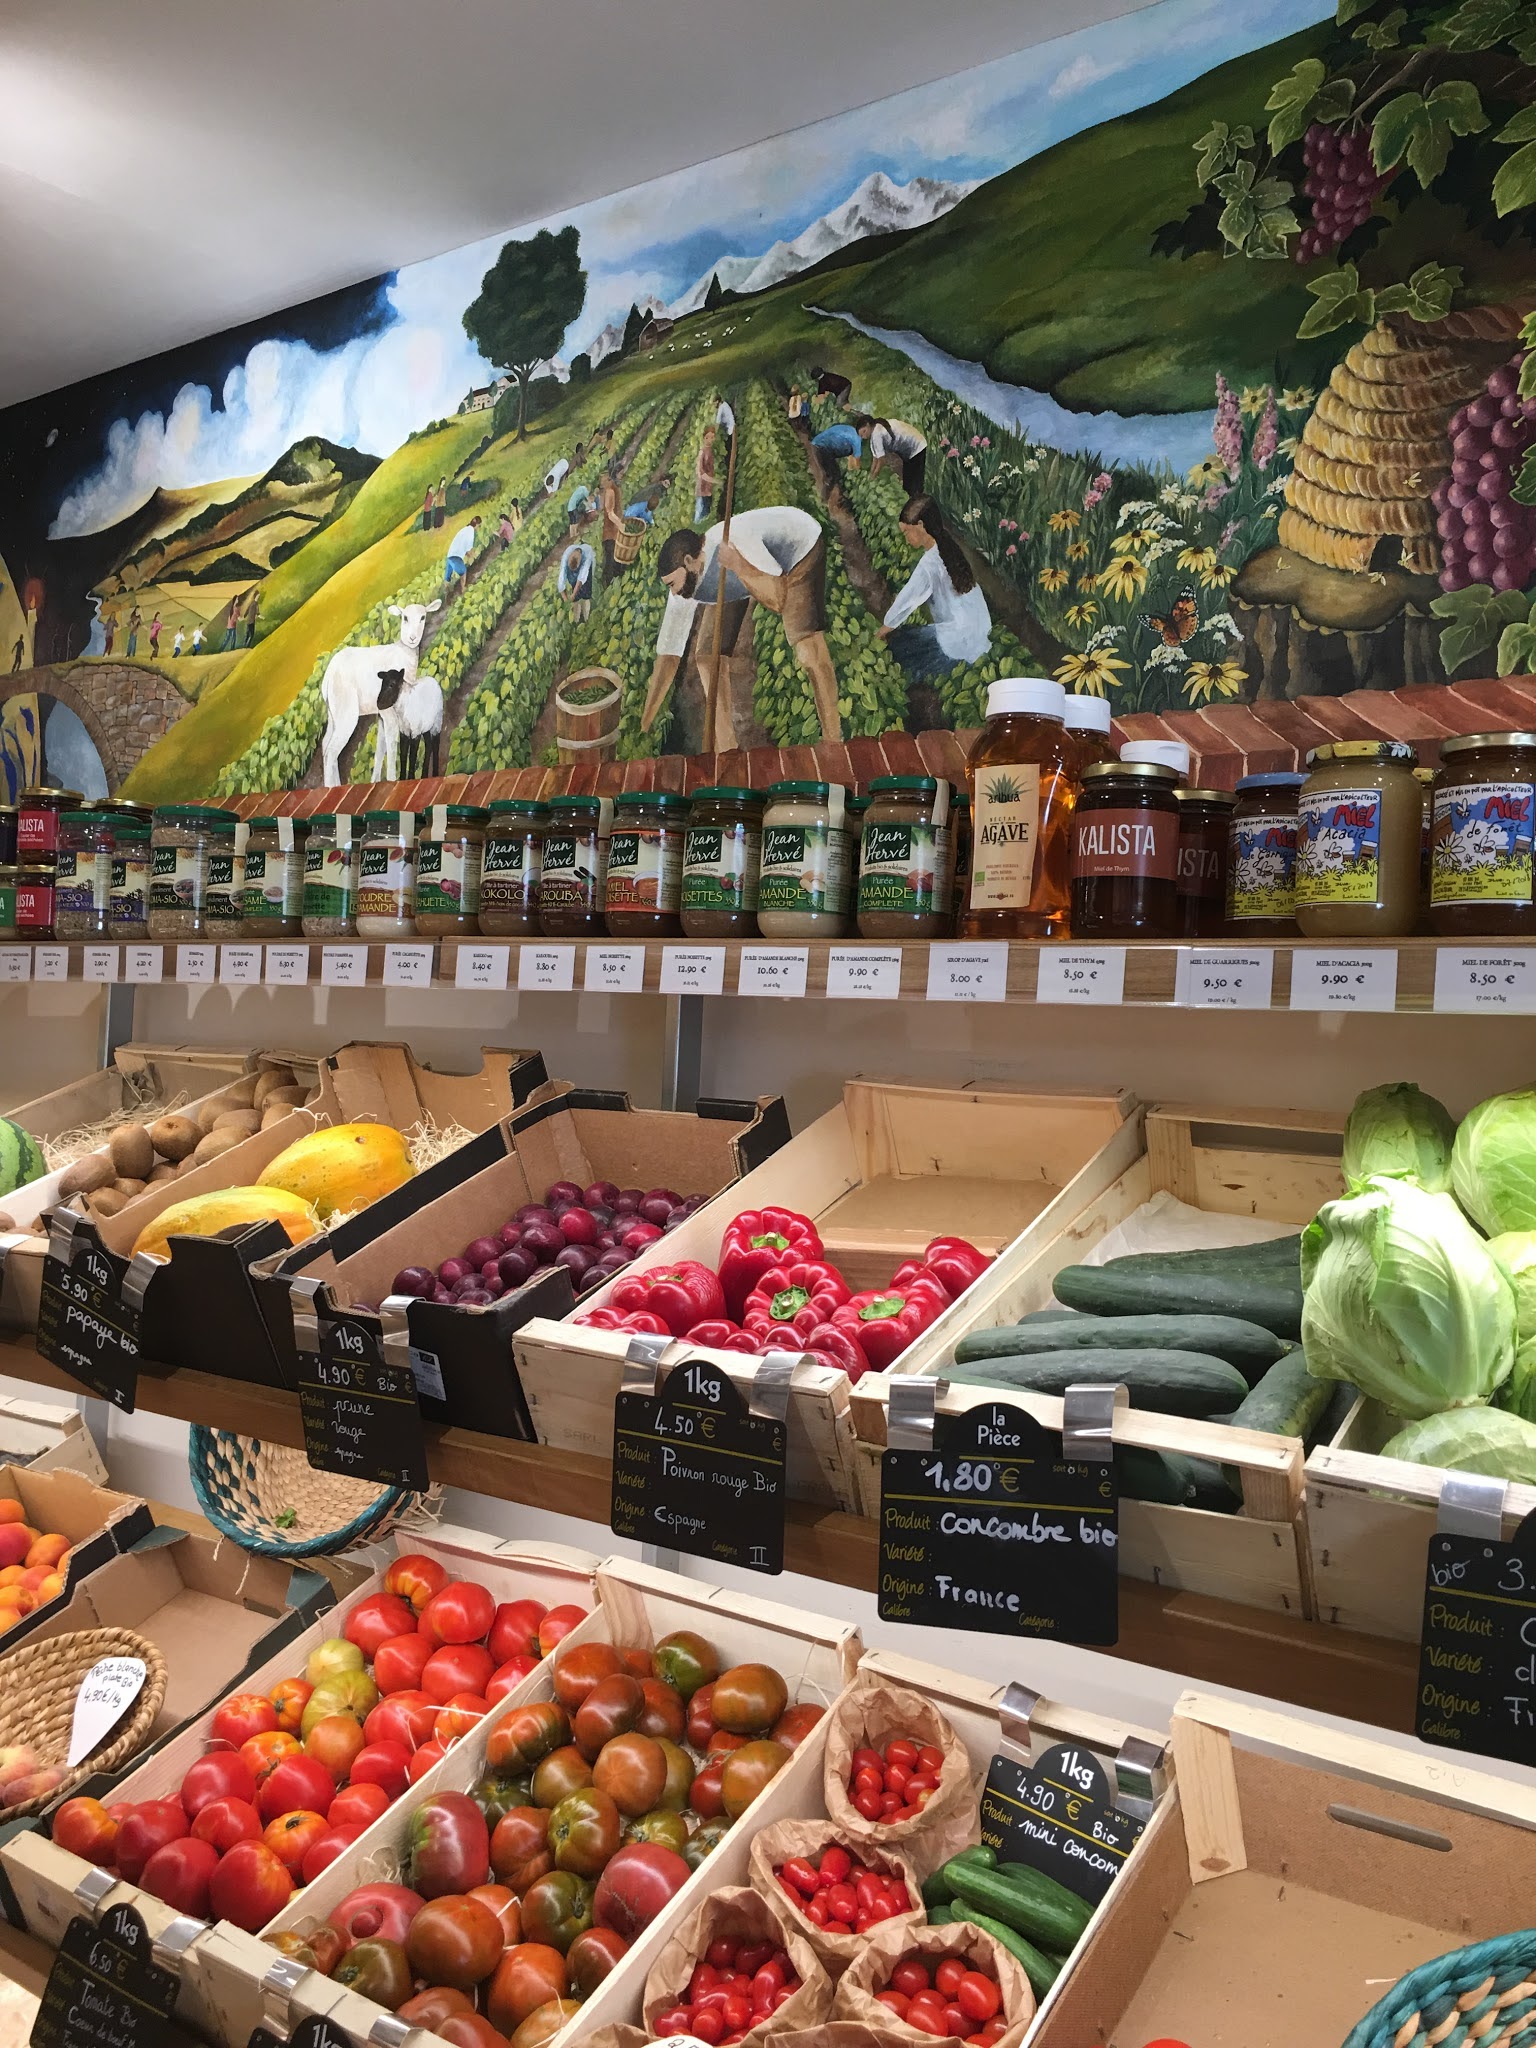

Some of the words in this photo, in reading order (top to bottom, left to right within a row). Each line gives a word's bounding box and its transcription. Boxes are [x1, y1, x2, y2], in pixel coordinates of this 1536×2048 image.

[1471, 787, 1480, 795] POT
[1493, 784, 1532, 793] L'APICULTEUR
[18, 819, 44, 832] ALISTA
[981, 823, 1029, 845] AGAVE
[1467, 821, 1481, 839] de
[1486, 820, 1524, 834] forêt
[545, 839, 572, 855] Jean
[688, 832, 718, 849] Jean
[768, 830, 800, 849] Jean
[871, 828, 907, 847] Jean
[1079, 824, 1156, 857] KALISTA
[1265, 825, 1297, 848] MIE
[362, 851, 385, 864] Jean
[489, 841, 519, 856] Jean
[685, 846, 720, 864] Hervé
[765, 845, 803, 863] Hervé
[866, 843, 909, 863] Hervé
[485, 855, 521, 871] Hervé
[543, 853, 574, 868] Hervé
[1094, 865, 1104, 873] Miel
[1114, 865, 1129, 874] Thym
[1178, 847, 1219, 880] ISTA
[873, 877, 894, 885] Purée
[757, 966, 778, 975] 10.60
[848, 968, 868, 977] 9.90
[1489, 958, 1512, 966] FORÊT
[950, 974, 970, 983] 8.00
[976, 975, 983, 983] €
[1063, 968, 1084, 981] 8.50
[1089, 971, 1097, 979] €
[1203, 978, 1227, 989] 9.50
[1234, 978, 1242, 987] €
[1321, 974, 1348, 984] 9.90
[1355, 975, 1365, 984] €
[1469, 972, 1497, 986] 8.50
[1505, 975, 1515, 984] €
[86, 1254, 109, 1286] 1kg
[60, 1274, 88, 1302] 5.90
[92, 1291, 102, 1309] €
[66, 1306, 117, 1349] papaye
[120, 1333, 138, 1355] bio
[335, 1327, 364, 1355] 1kg
[317, 1362, 350, 1385] 4.90
[354, 1367, 366, 1386] €
[377, 1377, 397, 1392] Bio
[684, 1366, 722, 1403] 1kg
[333, 1400, 375, 1422] prune
[992, 1406, 1005, 1427] la
[654, 1406, 694, 1436] 4.50
[701, 1417, 716, 1439] €
[772, 1437, 782, 1452] €
[977, 1425, 1021, 1447] Pièce
[306, 1436, 329, 1454] Origine
[616, 1470, 646, 1489] Variété
[617, 1441, 651, 1464] Produit
[661, 1446, 705, 1482] Poivron
[712, 1473, 749, 1498] rouge
[753, 1471, 777, 1493] Bio
[924, 1461, 992, 1493] 1,80
[999, 1467, 1020, 1493] €
[1077, 1463, 1089, 1476] kg
[1099, 1481, 1112, 1498] €
[614, 1496, 645, 1519] Origine
[654, 1505, 707, 1535] Espagne
[884, 1507, 931, 1531] Produit
[1079, 1517, 1118, 1547] bio
[749, 1546, 770, 1567] II
[883, 1542, 925, 1563] Variété
[1431, 1560, 1471, 1586] bio
[882, 1573, 925, 1601] Origine
[934, 1574, 1021, 1613] France
[882, 1602, 911, 1618] Calibre
[1429, 1603, 1494, 1637] Produit
[1018, 1612, 1055, 1632] Catégorie
[1425, 1645, 1483, 1675] Variété
[102, 1675, 121, 1684] plate
[121, 1678, 133, 1687] Bio
[1421, 1683, 1481, 1719] Origine
[1421, 1717, 1461, 1741] Calibre
[1061, 1751, 1095, 1790] 1kg
[1017, 1777, 1055, 1811] 4.90
[1066, 1800, 1082, 1821] €
[1092, 1821, 1119, 1845] Bio
[982, 1800, 1013, 1826] Produit
[1018, 1819, 1057, 1846] mini
[1063, 1839, 1120, 1876] concom
[115, 1909, 139, 1946] 1kg
[89, 1941, 112, 1973] 6.50
[79, 1978, 115, 2019] Tomate
[120, 2005, 138, 2028] Bio
